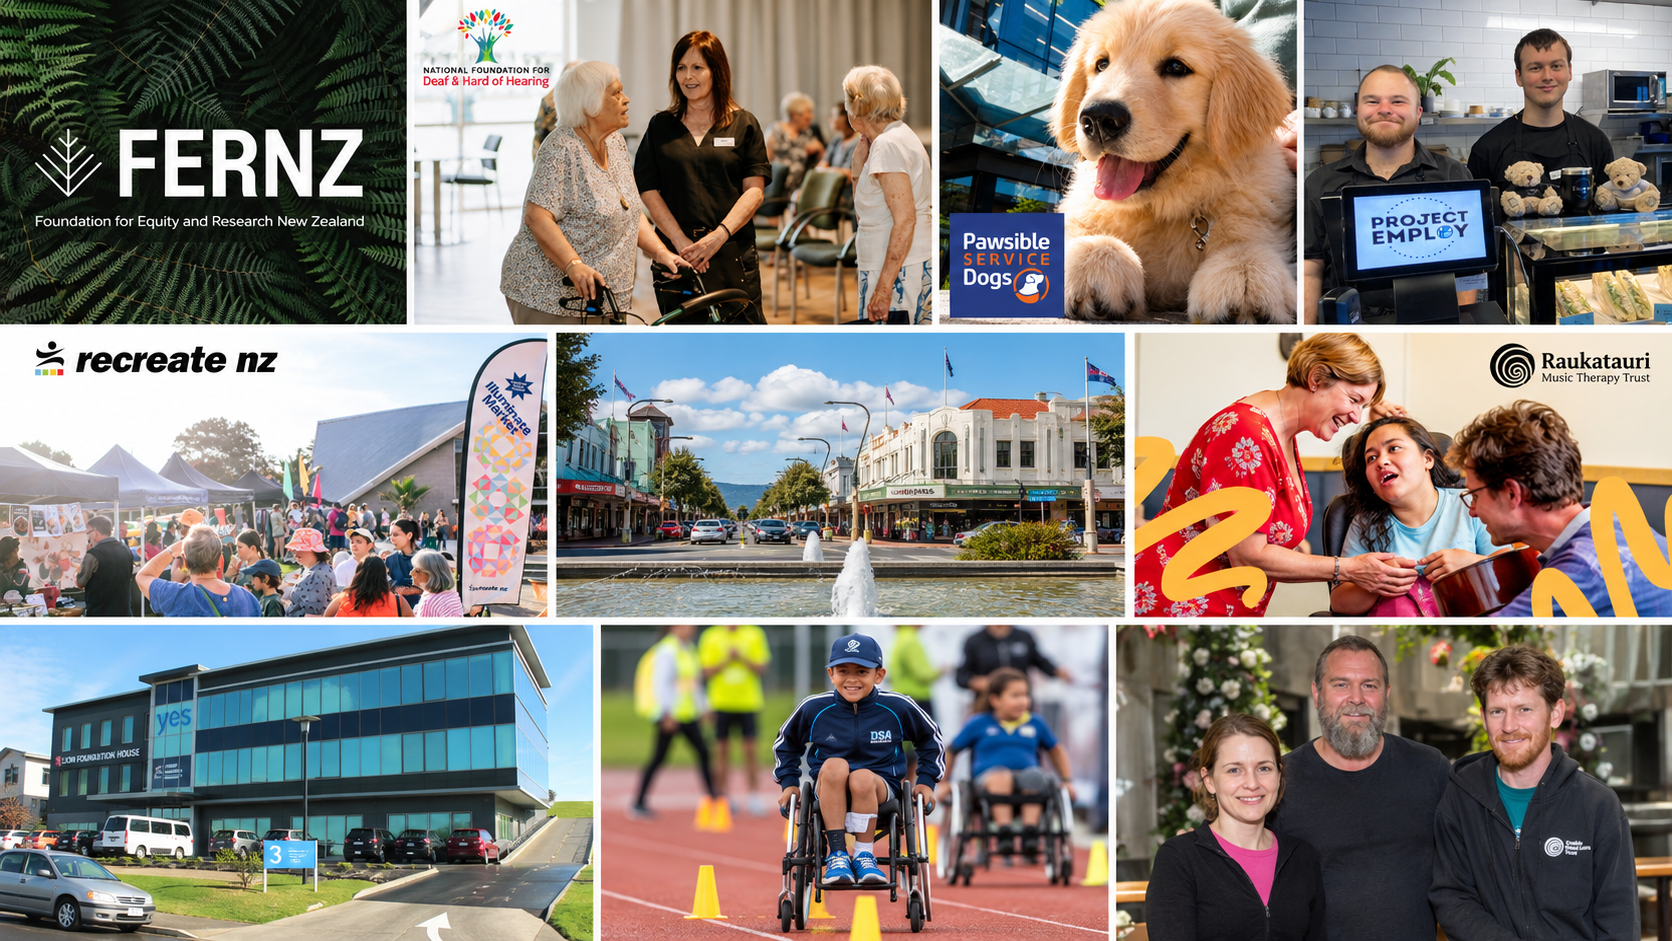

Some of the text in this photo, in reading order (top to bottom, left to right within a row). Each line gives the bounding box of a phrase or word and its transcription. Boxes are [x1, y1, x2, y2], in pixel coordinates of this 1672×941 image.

[1371, 210, 1469, 229] PROJECT
[156, 708, 191, 735] yes
[870, 730, 892, 740] DSA
[269, 845, 282, 864] 3
